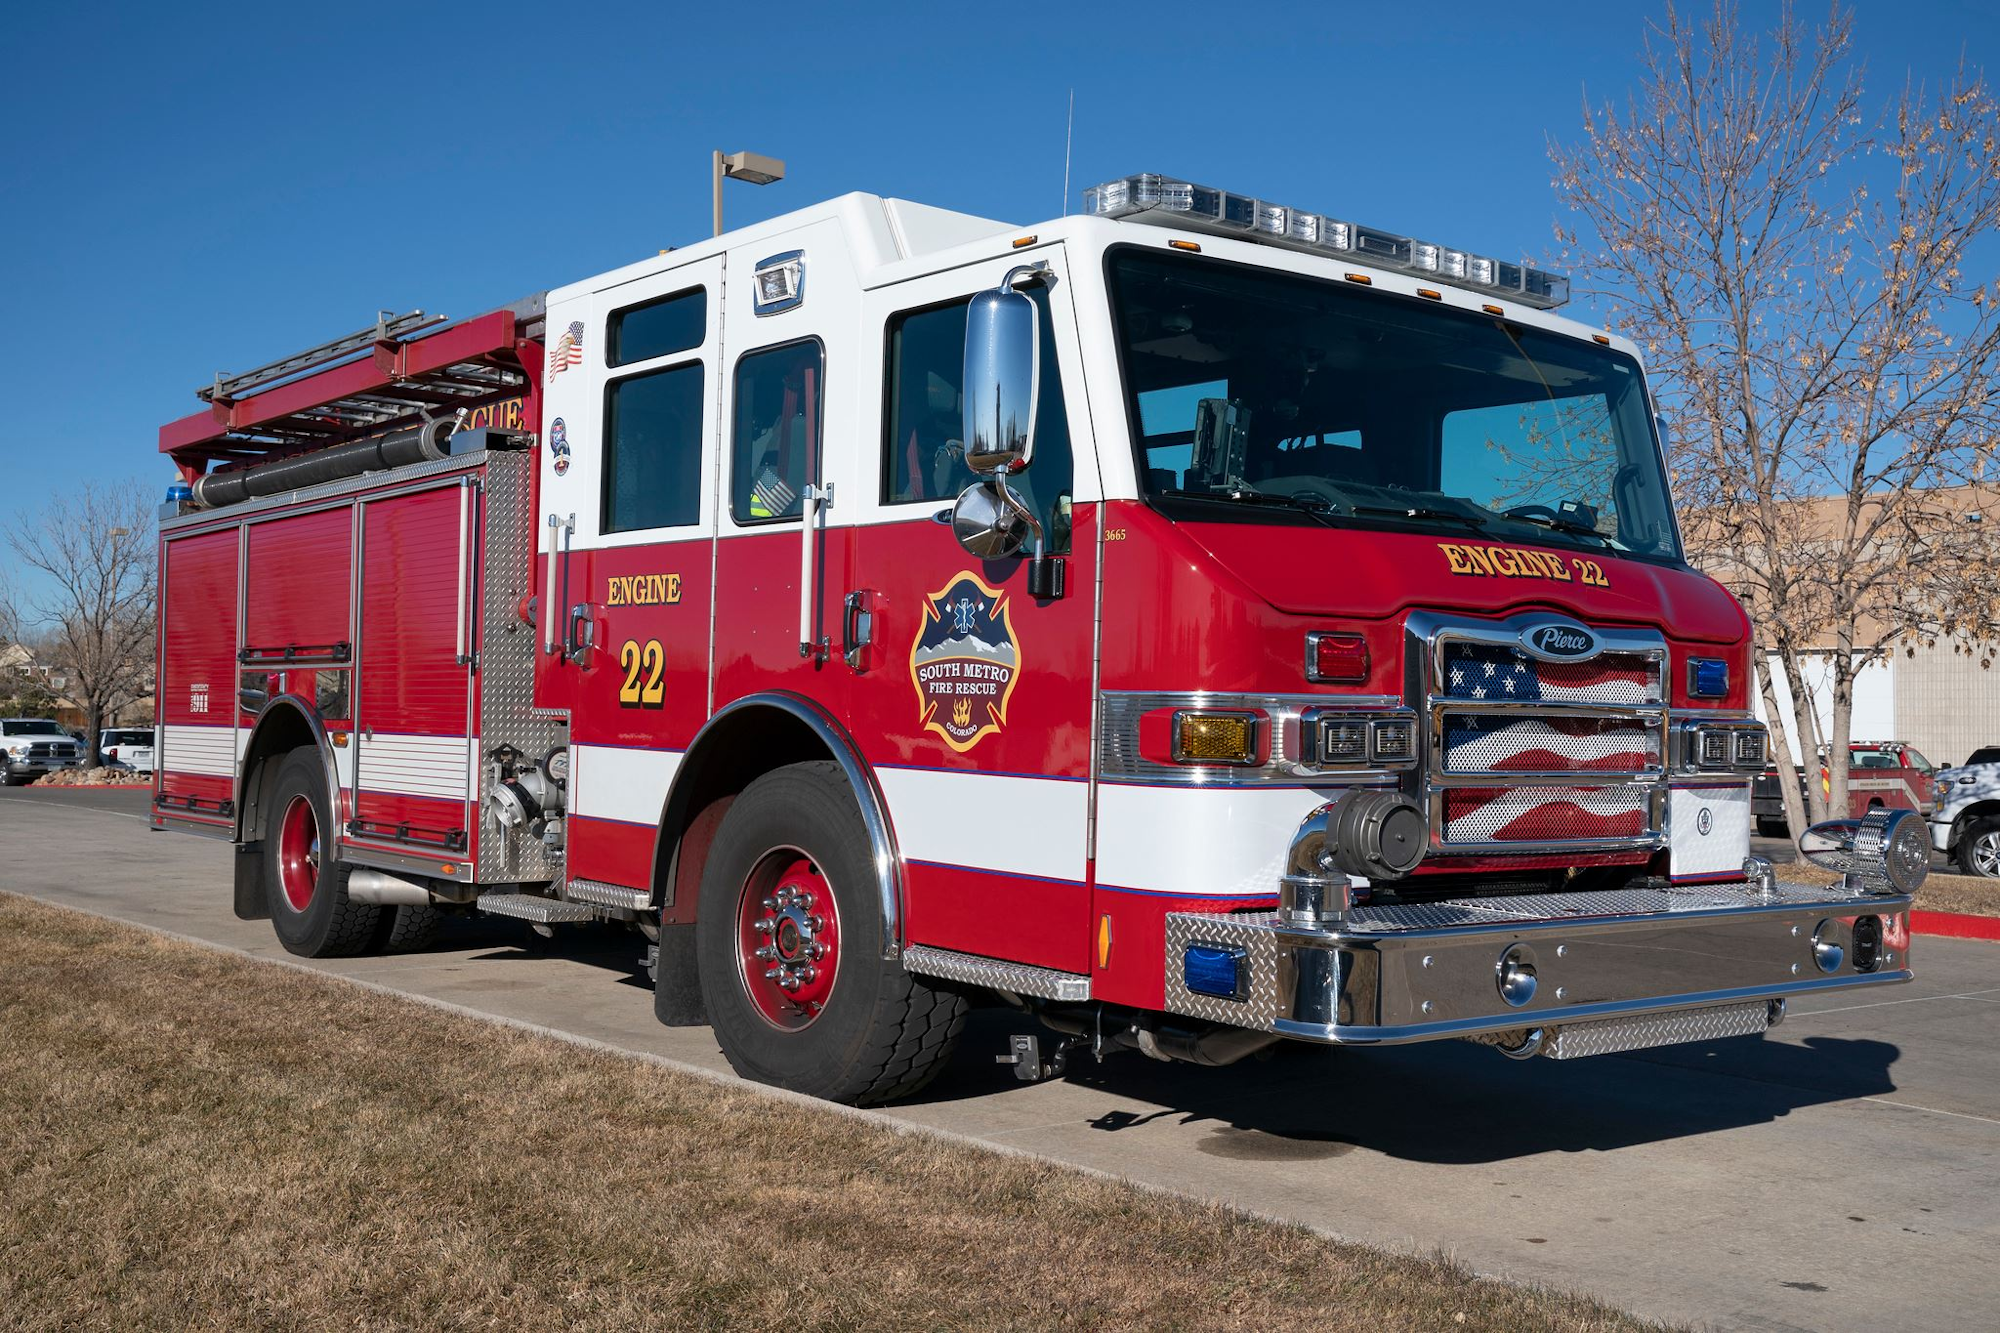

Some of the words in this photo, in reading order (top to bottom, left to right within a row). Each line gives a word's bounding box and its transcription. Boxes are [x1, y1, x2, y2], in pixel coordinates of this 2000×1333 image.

[464, 397, 524, 431] CUE
[1104, 528, 1126, 541] 3665
[1437, 543, 1573, 582] ENGINE
[1571, 558, 1610, 588] 22
[607, 573, 682, 606] ENGINE
[1540, 627, 1587, 651] Pierce
[619, 638, 666, 709] 22
[919, 662, 961, 683] SOUTH
[963, 662, 1009, 683] METRO
[929, 681, 953, 694] FIRE
[955, 682, 997, 695] RESCUE
[946, 722, 978, 737] COLORADO
